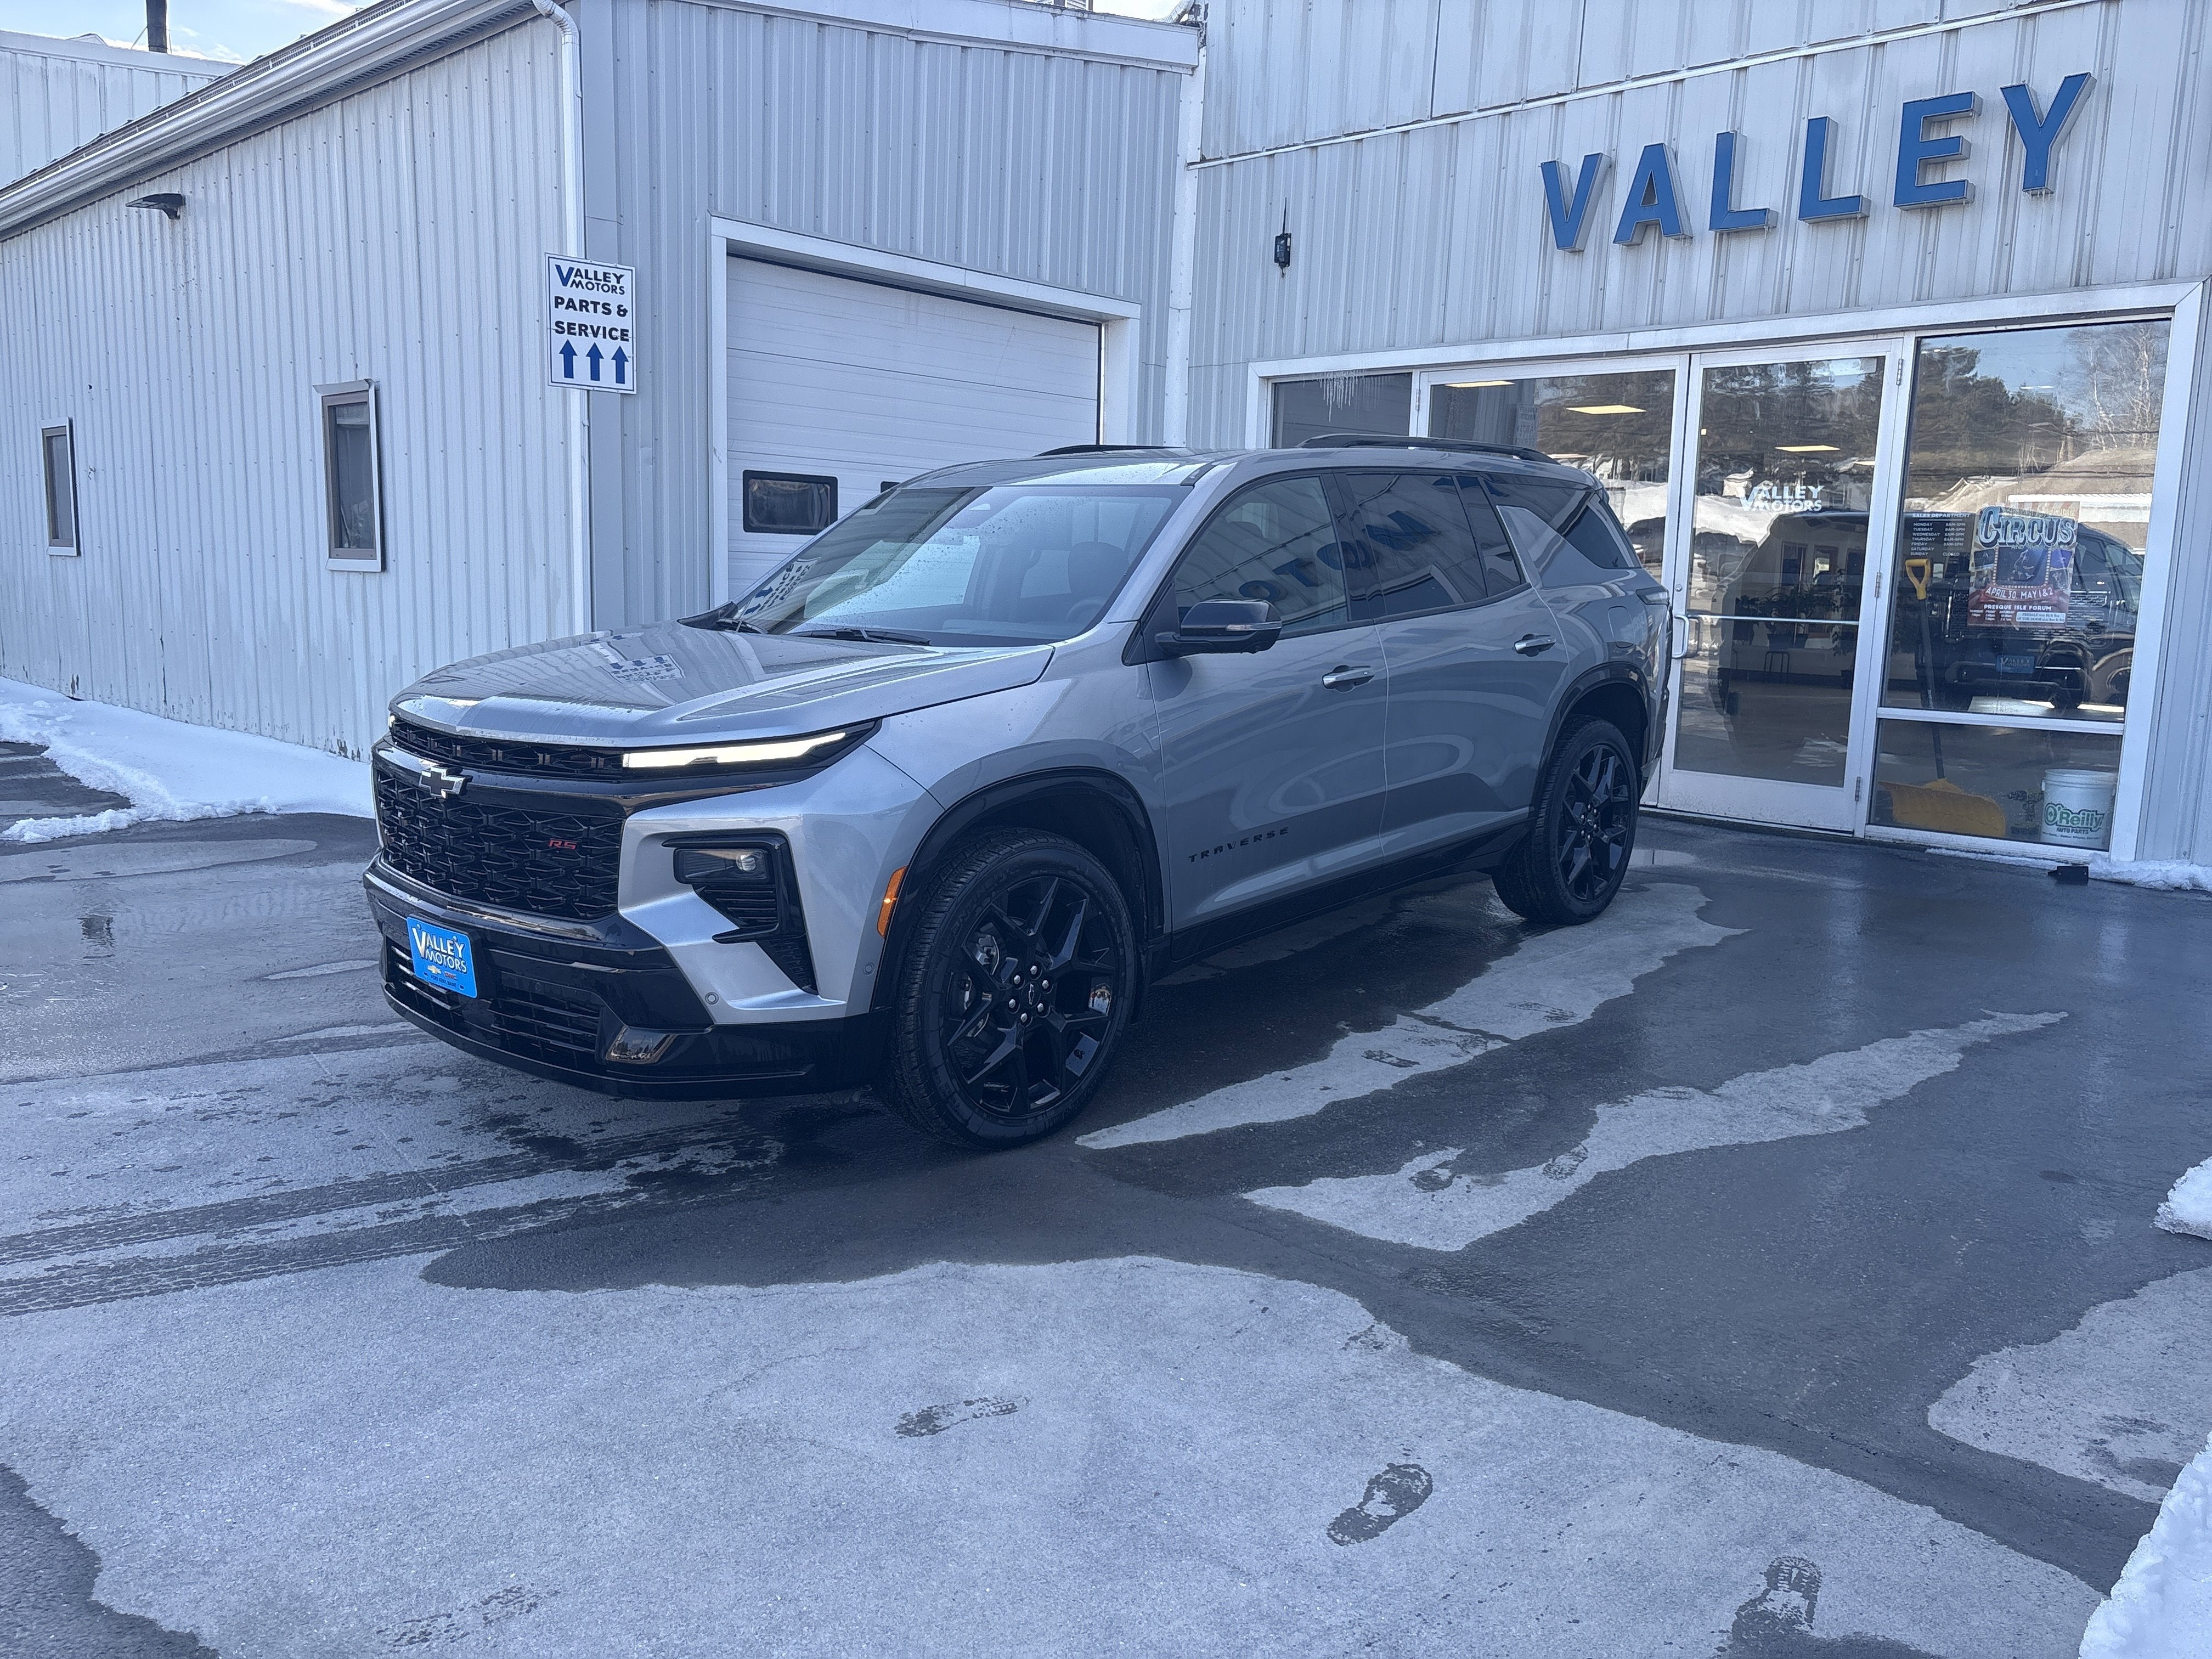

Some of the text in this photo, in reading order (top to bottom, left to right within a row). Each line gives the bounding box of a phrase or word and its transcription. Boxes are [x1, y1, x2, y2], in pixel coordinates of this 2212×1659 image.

[1541, 72, 2097, 252] VALLEY
[555, 264, 625, 287] VALLEY
[569, 279, 625, 295] MOTORS
[555, 296, 628, 317] PARTS &
[555, 320, 629, 342] SERVICE
[1736, 485, 1825, 511] VALLEY
[1751, 500, 1822, 511] MOTORS
[1978, 506, 2078, 549] CIRCUS
[1985, 586, 2006, 598] APRIL
[2021, 590, 2036, 599] MAY
[2042, 589, 2048, 597] &
[2048, 587, 2053, 595] 2
[2046, 804, 2103, 830] O'Reilly
[549, 840, 577, 850] RS
[1188, 827, 1289, 862] TRAVERSE
[412, 927, 465, 958] VALLEY
[426, 949, 467, 973] MOTORS
